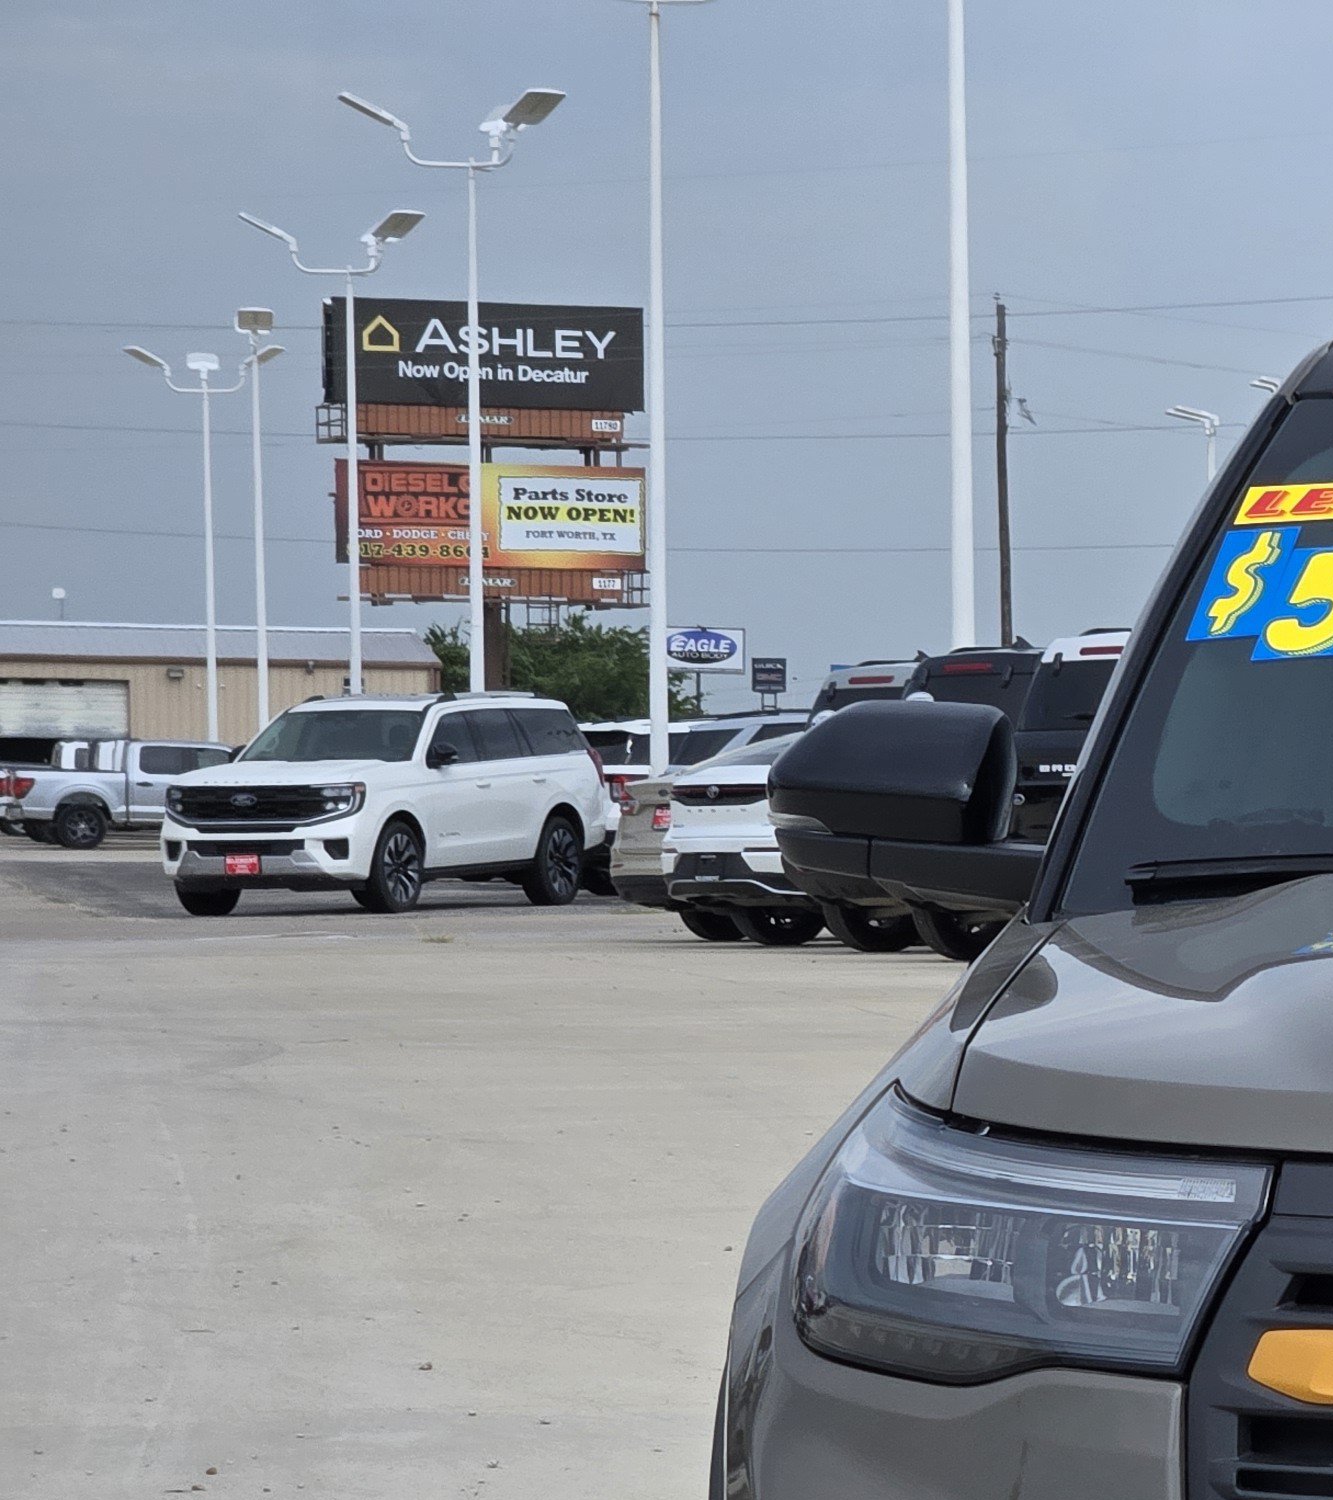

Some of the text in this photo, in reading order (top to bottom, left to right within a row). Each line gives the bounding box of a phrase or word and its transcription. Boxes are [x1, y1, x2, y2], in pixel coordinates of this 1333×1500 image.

[414, 318, 617, 360] ASHLEY
[398, 360, 589, 384] Now Opn in Decatur
[459, 416, 509, 425] LMAR
[513, 487, 629, 503] Parts Store
[506, 505, 636, 523] NOW OPEN!
[357, 528, 383, 539] ORD
[392, 529, 438, 539] DODGE
[526, 530, 554, 539] FORT
[601, 532, 617, 541] TX
[670, 635, 732, 653] EAGLE
